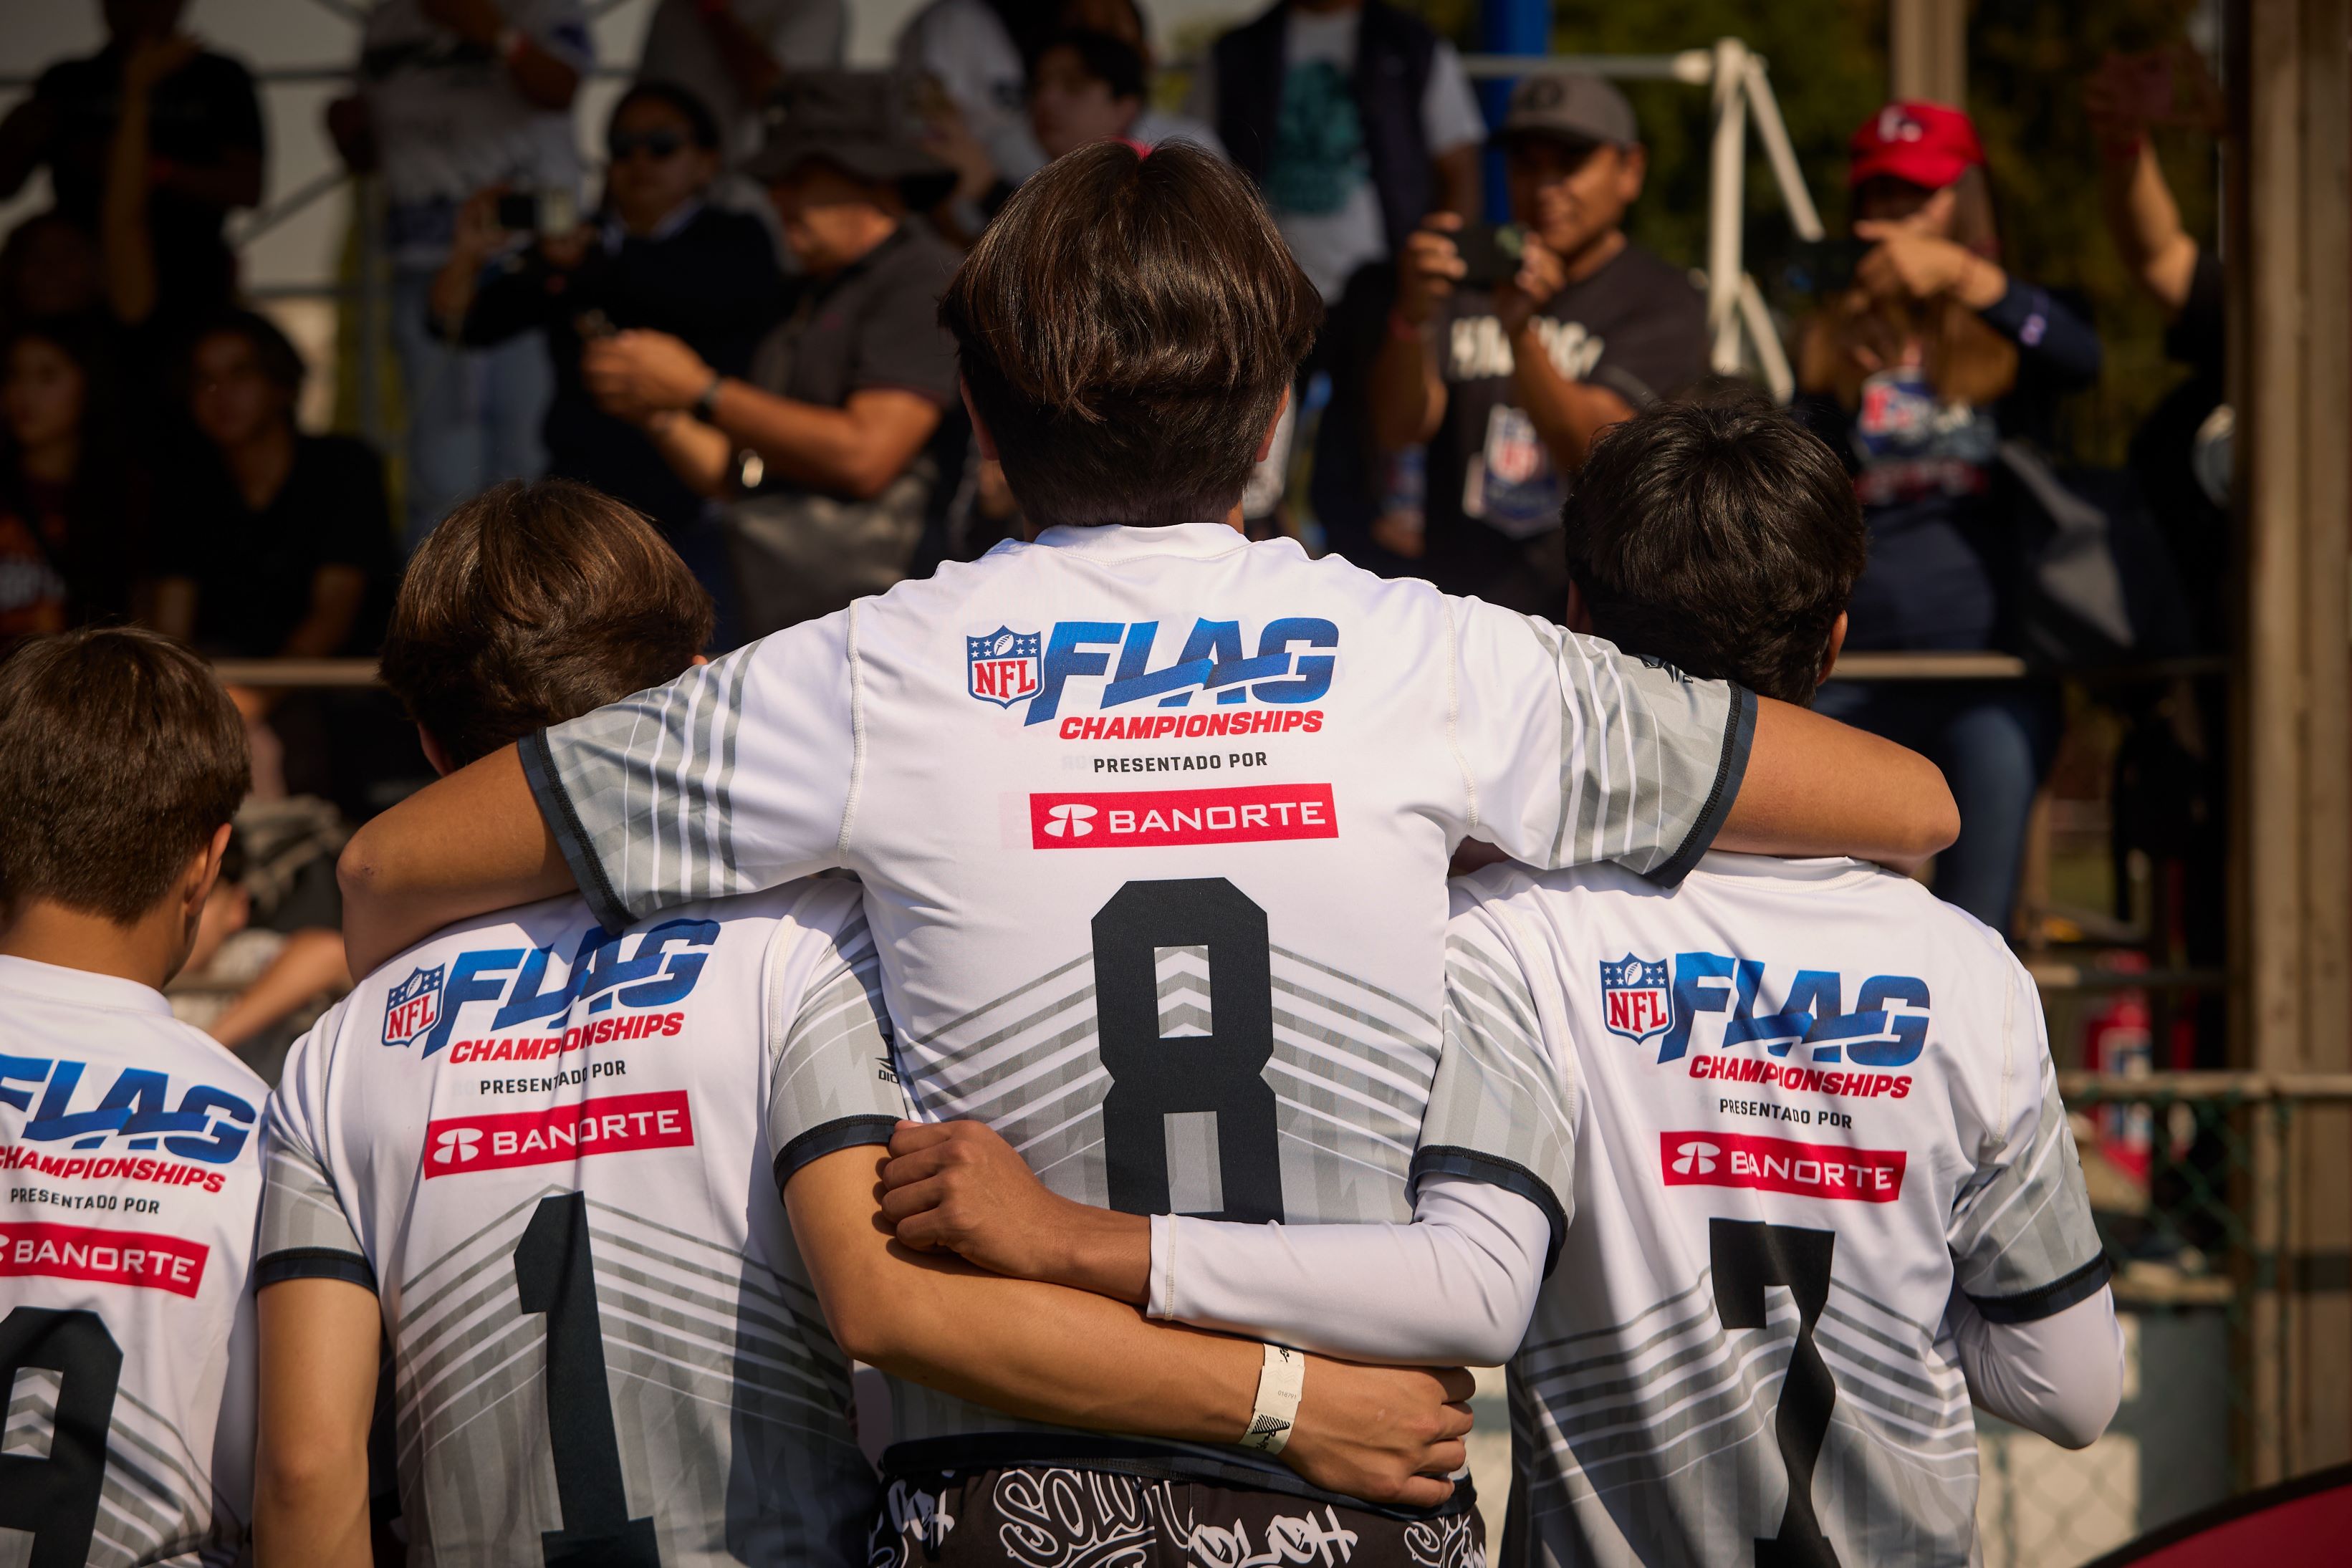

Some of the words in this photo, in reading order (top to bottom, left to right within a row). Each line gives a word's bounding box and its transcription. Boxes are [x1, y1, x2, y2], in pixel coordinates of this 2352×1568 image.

[975, 660, 1036, 699] NFL
[1024, 617, 1340, 727] FLAG
[1059, 710, 1324, 740] CHAMPIONSHIPS
[1093, 754, 1221, 773] PRESENTADO
[1230, 751, 1267, 768] POR
[1108, 802, 1326, 835] BANORTE
[387, 994, 434, 1040] NFL
[421, 918, 721, 1060] FLAG
[1608, 990, 1667, 1033] NFL
[1656, 951, 1931, 1067] FLAG
[592, 1060, 626, 1079] POR
[1091, 877, 1285, 1226] 8
[1689, 1055, 1912, 1099] CHAMPIONSHIPS
[492, 1109, 682, 1156] BANORTE
[1719, 1099, 1810, 1125] PRESENTADO
[1818, 1111, 1852, 1130] POR
[1730, 1151, 1894, 1191] BANORTE
[10, 1188, 117, 1211] PRESENTADO
[124, 1197, 160, 1214] POR
[14, 1239, 196, 1284] BANORTE
[513, 1190, 662, 1568] 1
[1709, 1216, 1842, 1568] 7
